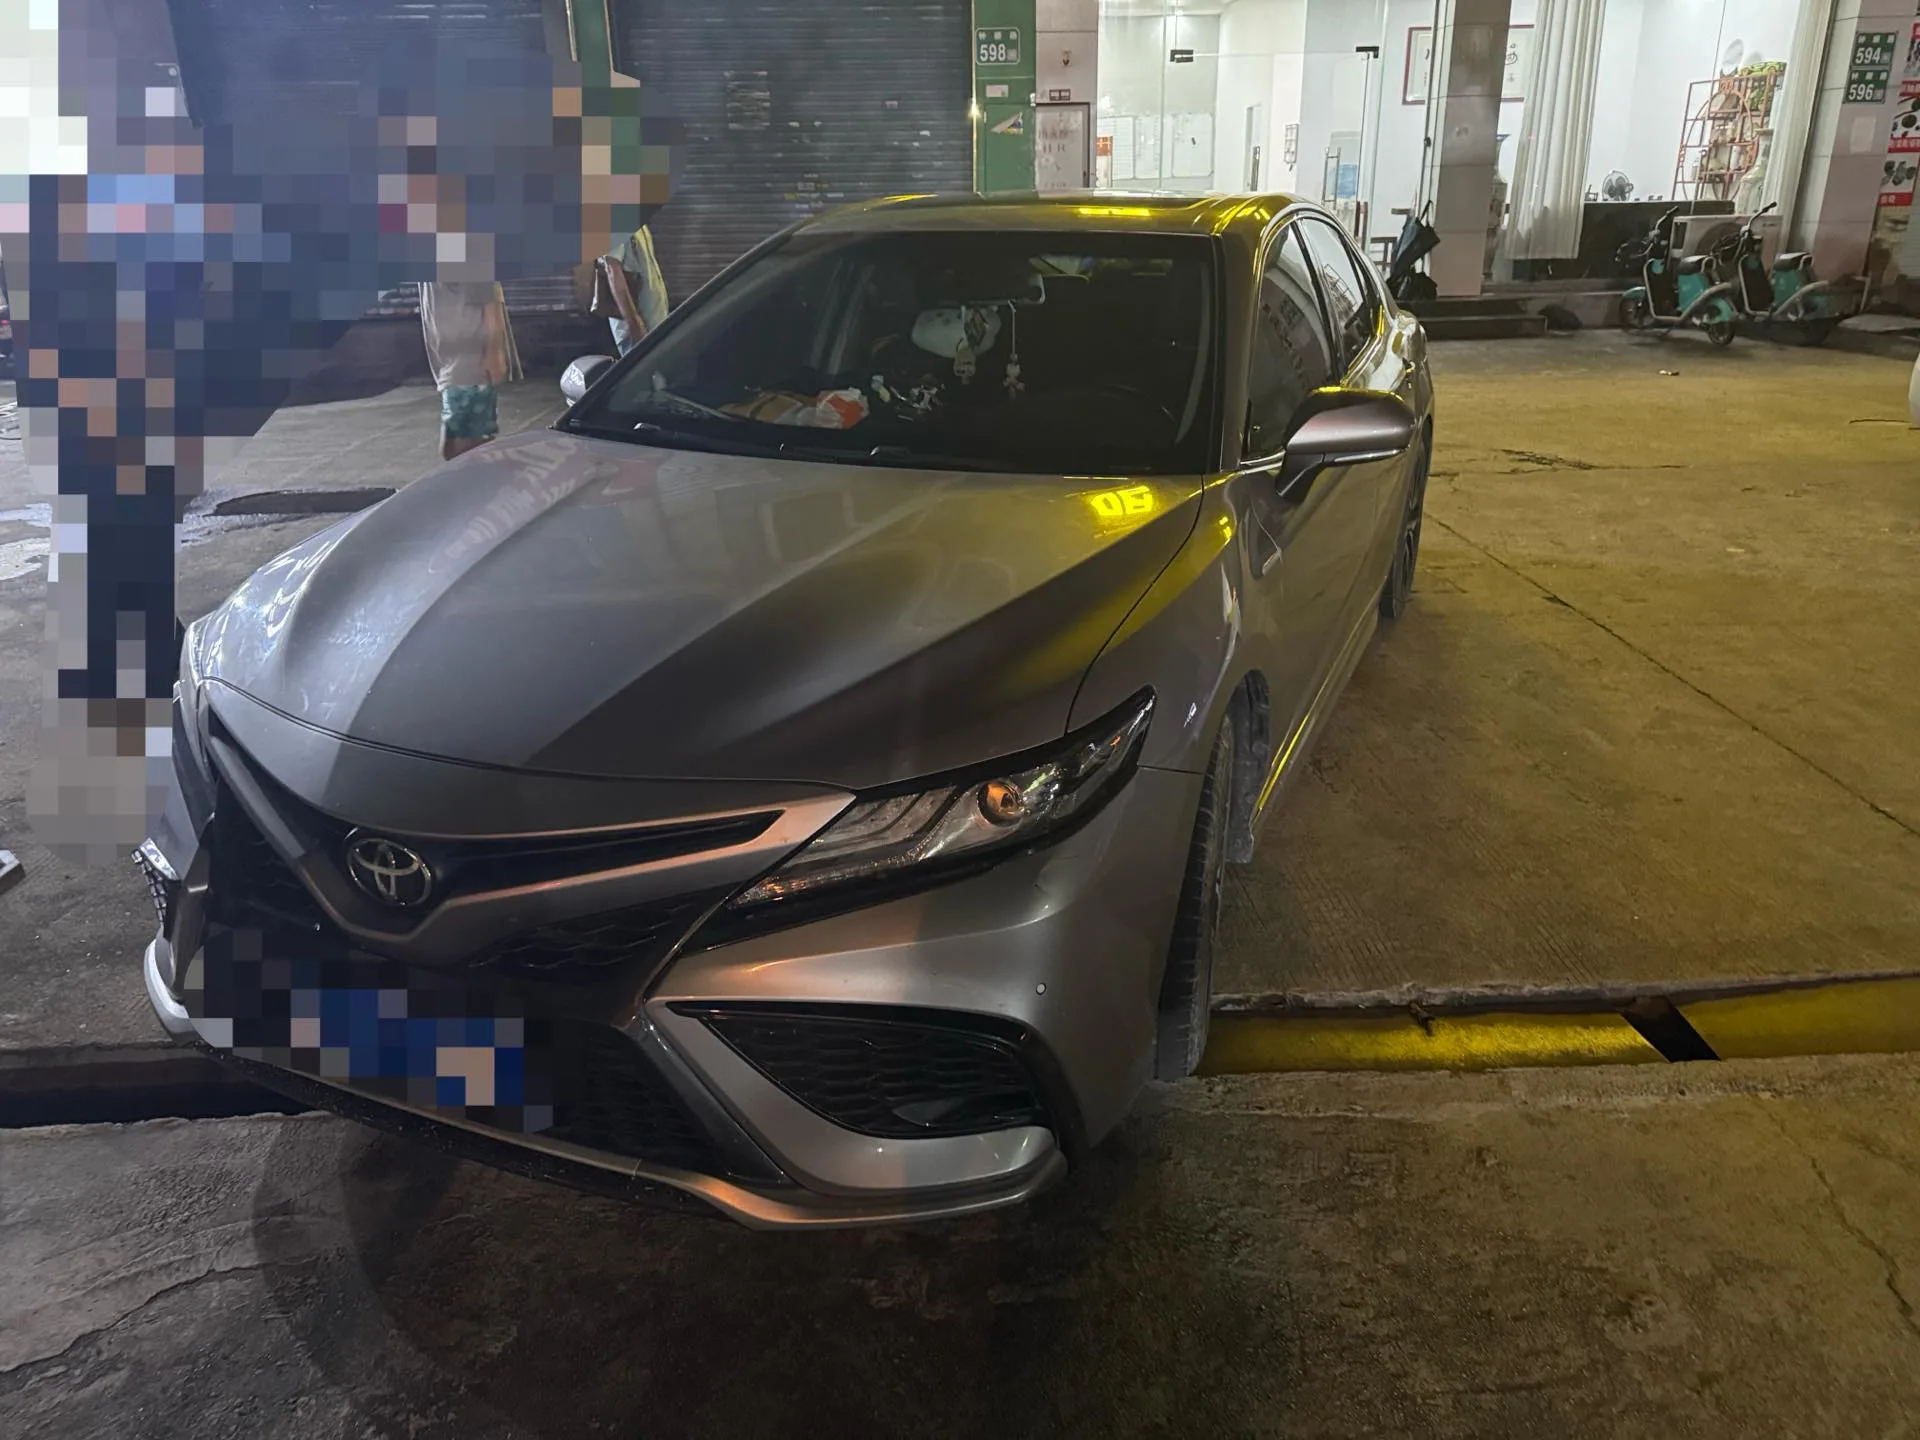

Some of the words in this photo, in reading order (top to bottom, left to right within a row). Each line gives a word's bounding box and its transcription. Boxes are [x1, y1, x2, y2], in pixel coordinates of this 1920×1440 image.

[980, 43, 1006, 62] 598
[1855, 47, 1881, 64] 594
[1848, 84, 1874, 100] 596
